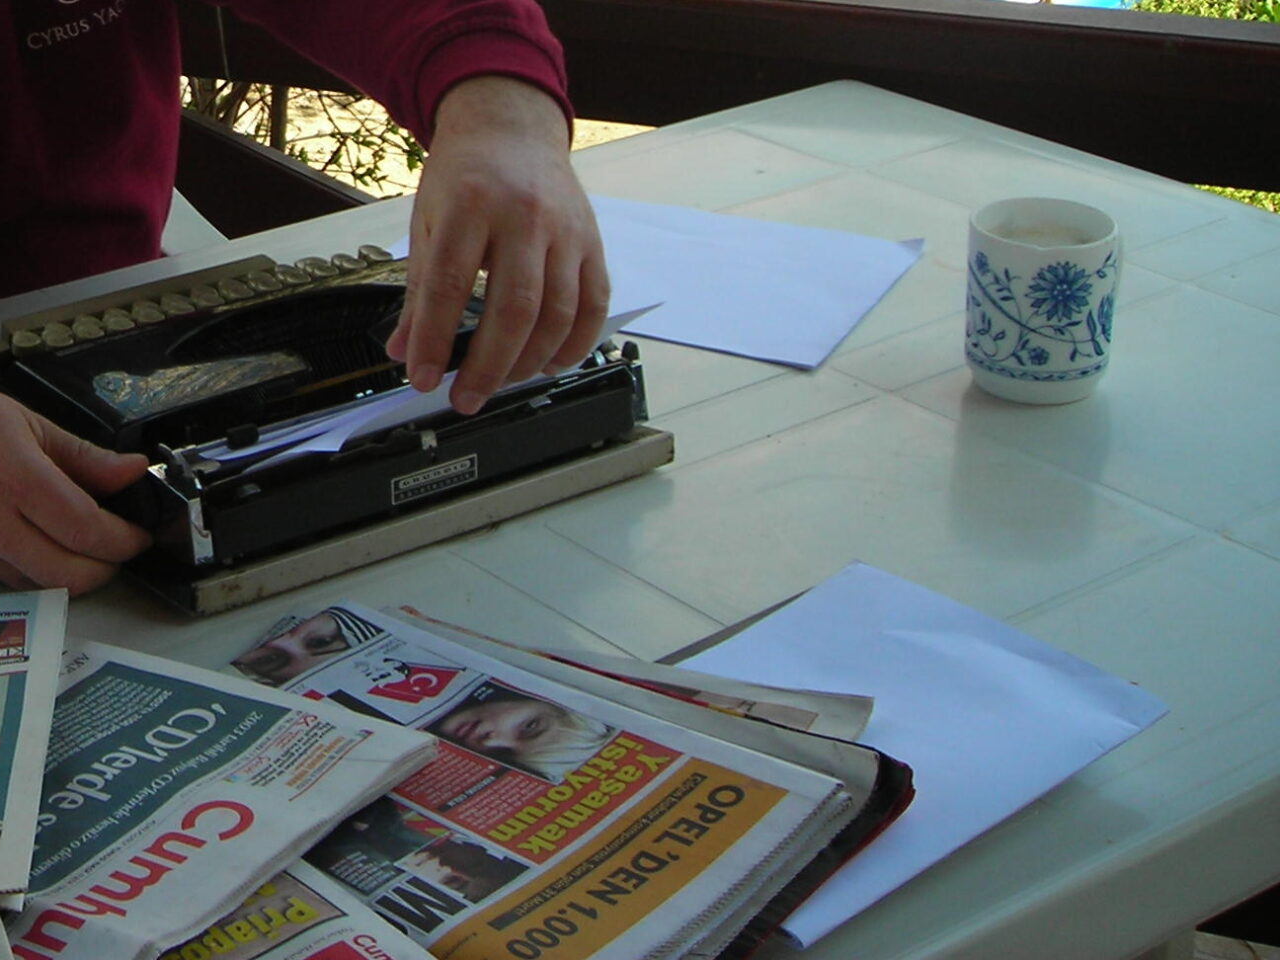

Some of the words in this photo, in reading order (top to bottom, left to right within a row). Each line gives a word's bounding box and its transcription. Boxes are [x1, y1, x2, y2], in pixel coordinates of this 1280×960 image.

[26, 18, 91, 50] CYRUS
[234, 710, 262, 738] 2003
[487, 734, 645, 843] istiyorum
[516, 752, 671, 855] Yaşamak
[585, 784, 746, 906] OPEL'DEN
[160, 897, 318, 960] Priapo
[505, 901, 598, 960] 1.000
